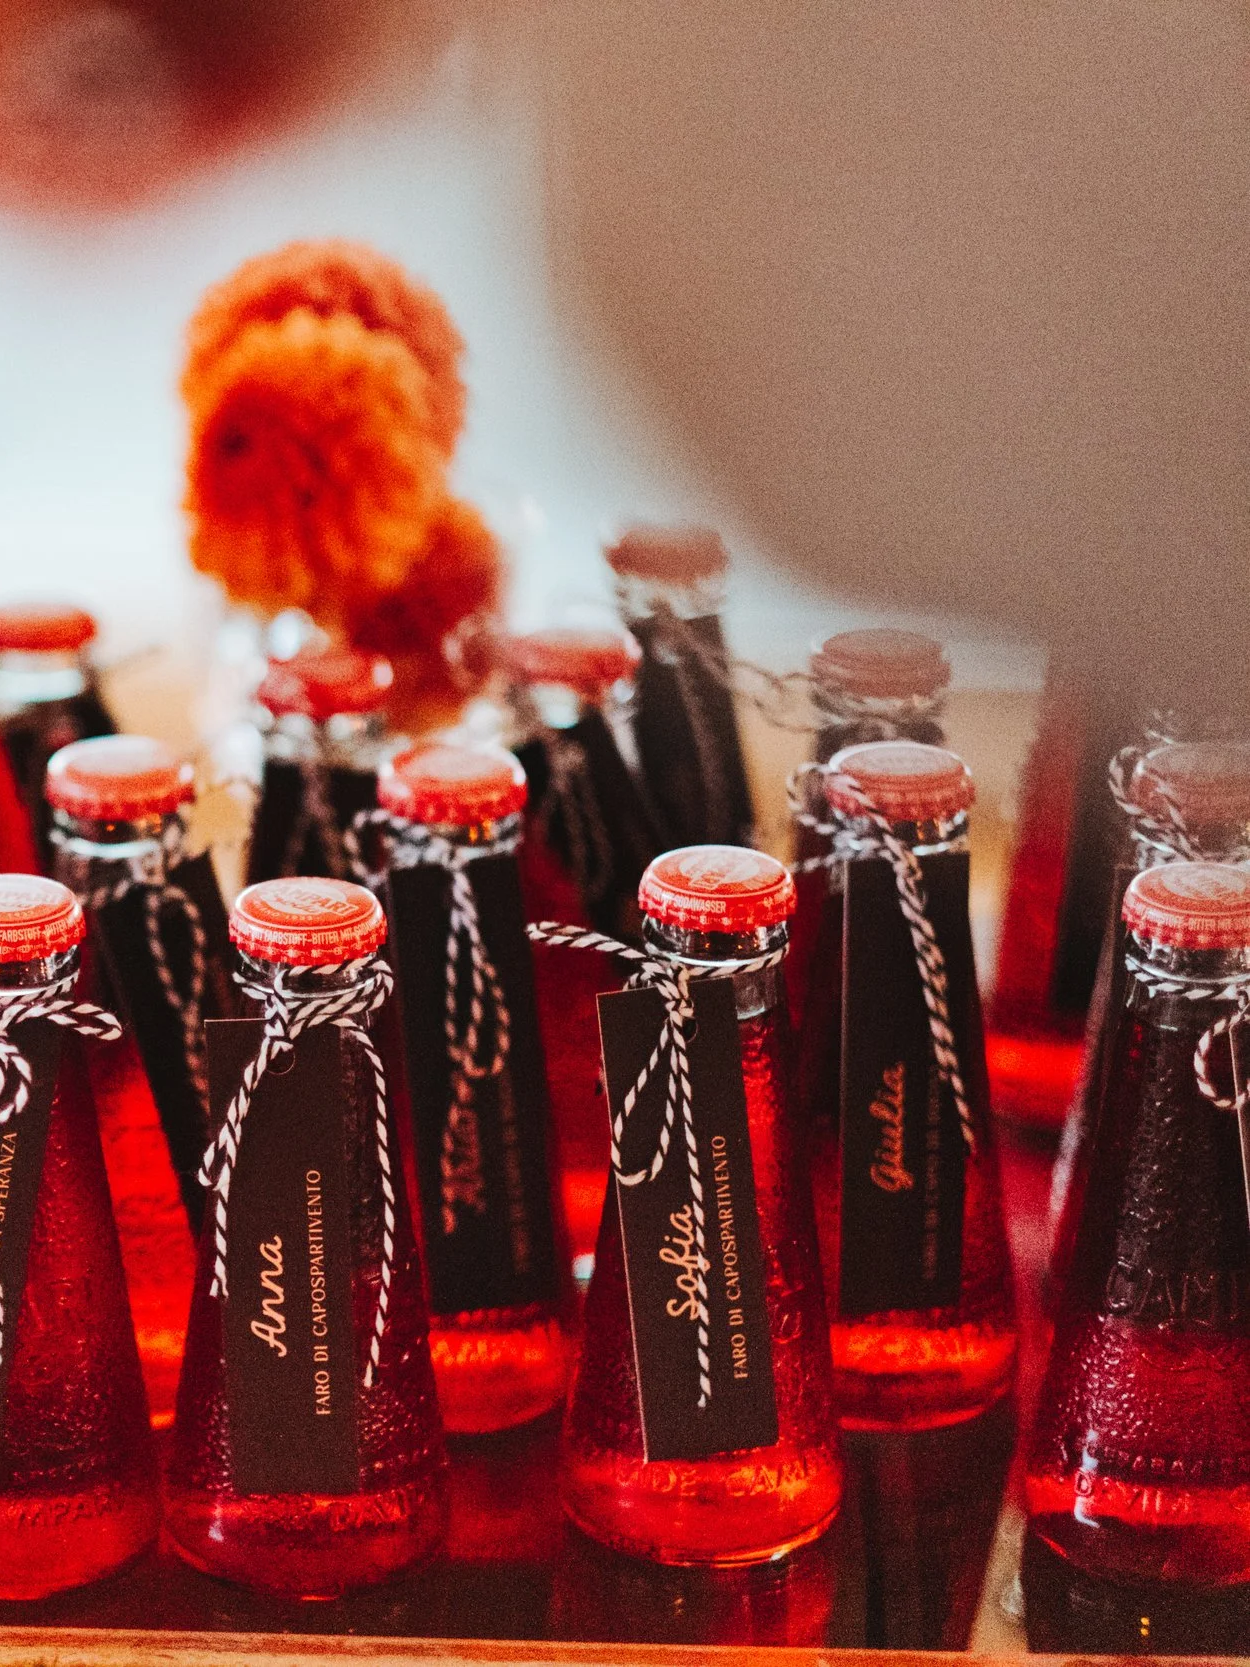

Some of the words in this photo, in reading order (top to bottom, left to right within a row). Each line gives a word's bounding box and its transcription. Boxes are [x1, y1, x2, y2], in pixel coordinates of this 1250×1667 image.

[869, 1061, 914, 1193] Giulia
[305, 1169, 329, 1338] CAPOSPARTIVENTO
[658, 1204, 712, 1321] Sofia
[711, 1135, 742, 1302] CAPOSPARTIVENTO
[249, 1235, 288, 1358] Anna
[313, 1344, 330, 1362] DI
[728, 1307, 744, 1326] DI
[314, 1369, 332, 1416] FARO
[730, 1332, 749, 1379] FARO
